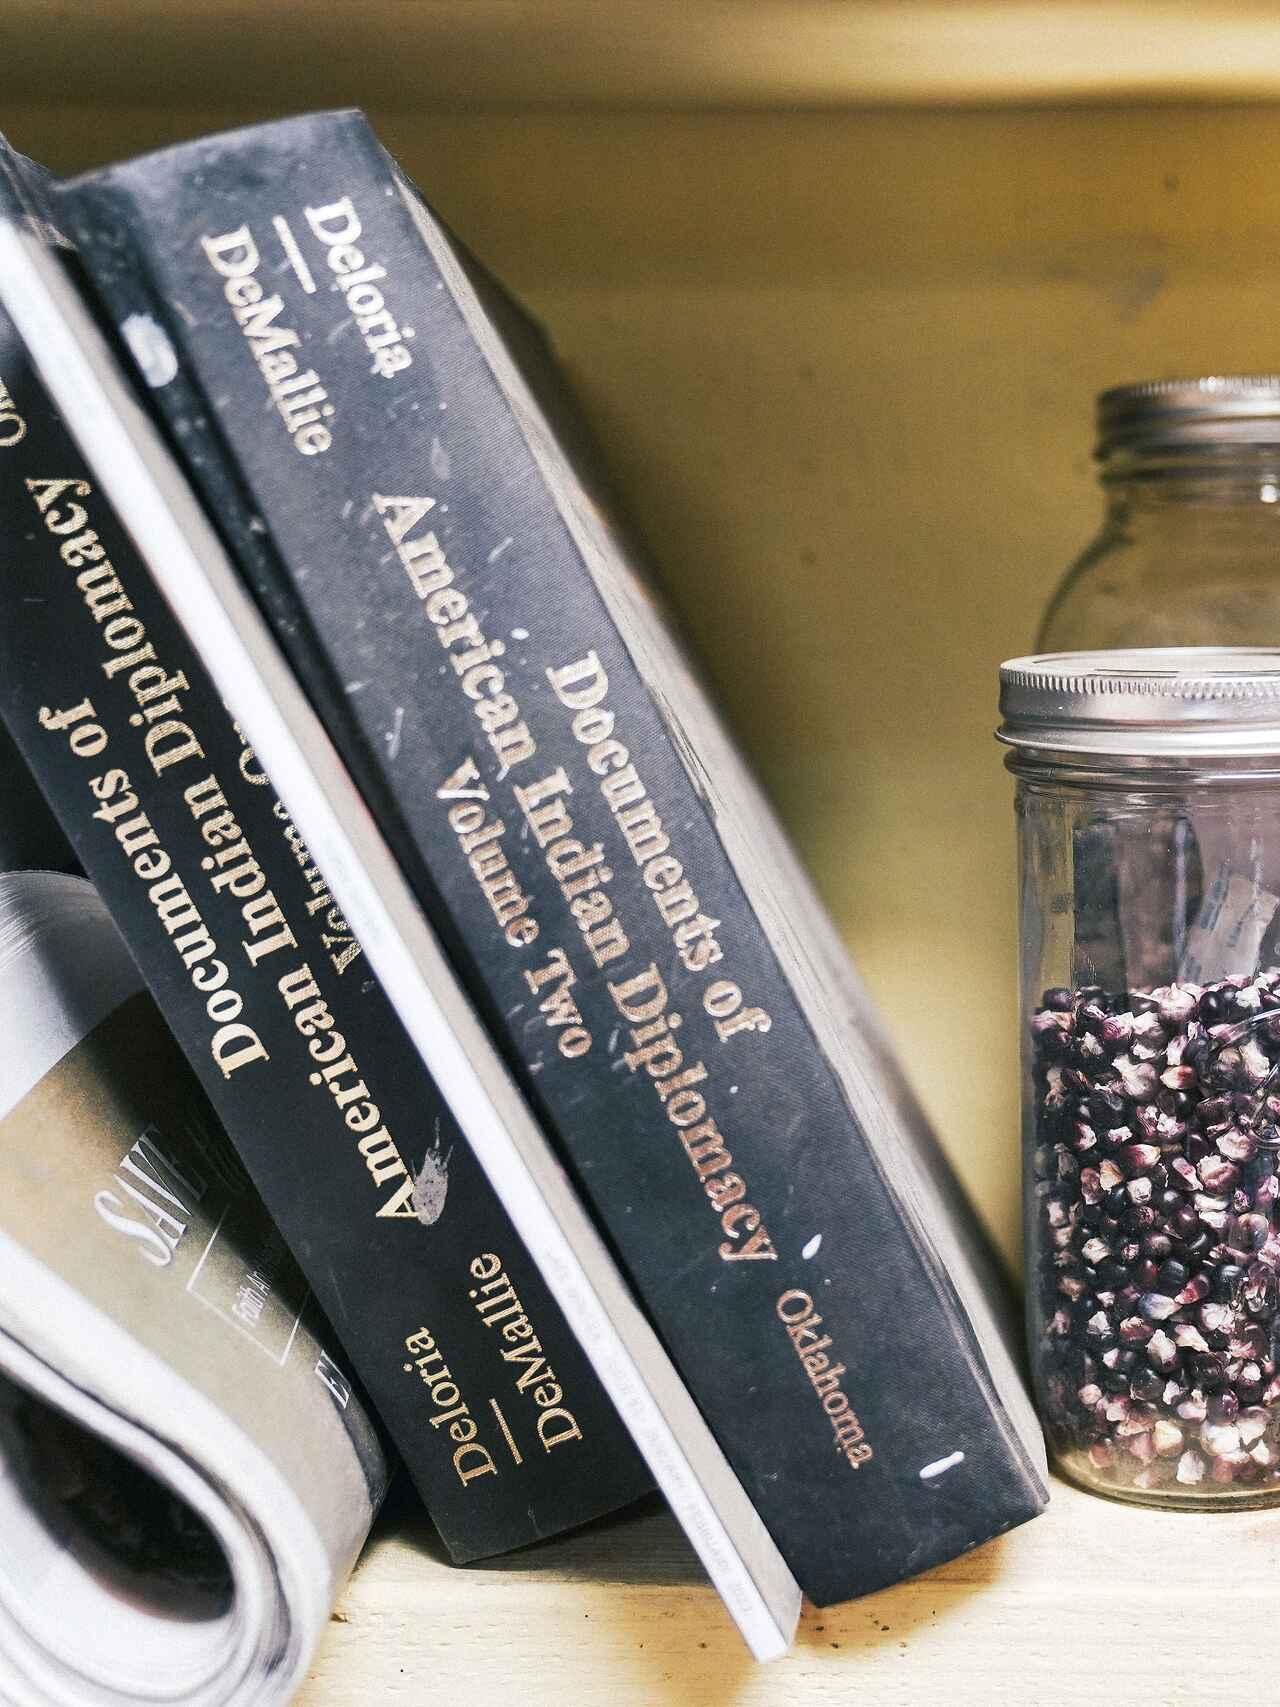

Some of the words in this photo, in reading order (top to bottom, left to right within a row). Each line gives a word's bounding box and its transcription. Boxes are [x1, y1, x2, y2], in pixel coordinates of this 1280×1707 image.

[200, 224, 333, 456] DeMallie
[303, 196, 413, 379] Deloria
[24, 478, 205, 778] Diplomacy
[38, 698, 108, 757] of
[88, 768, 270, 1079] Documents
[184, 773, 298, 967] Indian
[372, 493, 536, 767] American
[512, 767, 631, 967] Indian
[608, 963, 778, 1261] Diplomacy
[436, 757, 540, 947] Volume
[523, 948, 591, 1058] Two
[544, 650, 724, 971] Documents
[702, 980, 771, 1042] of
[94, 1124, 208, 1267] SAVE
[278, 963, 421, 1220] American
[403, 1326, 499, 1487] Deloria
[470, 1252, 583, 1453] DeMallie
[776, 1289, 872, 1469] Oklahoma
